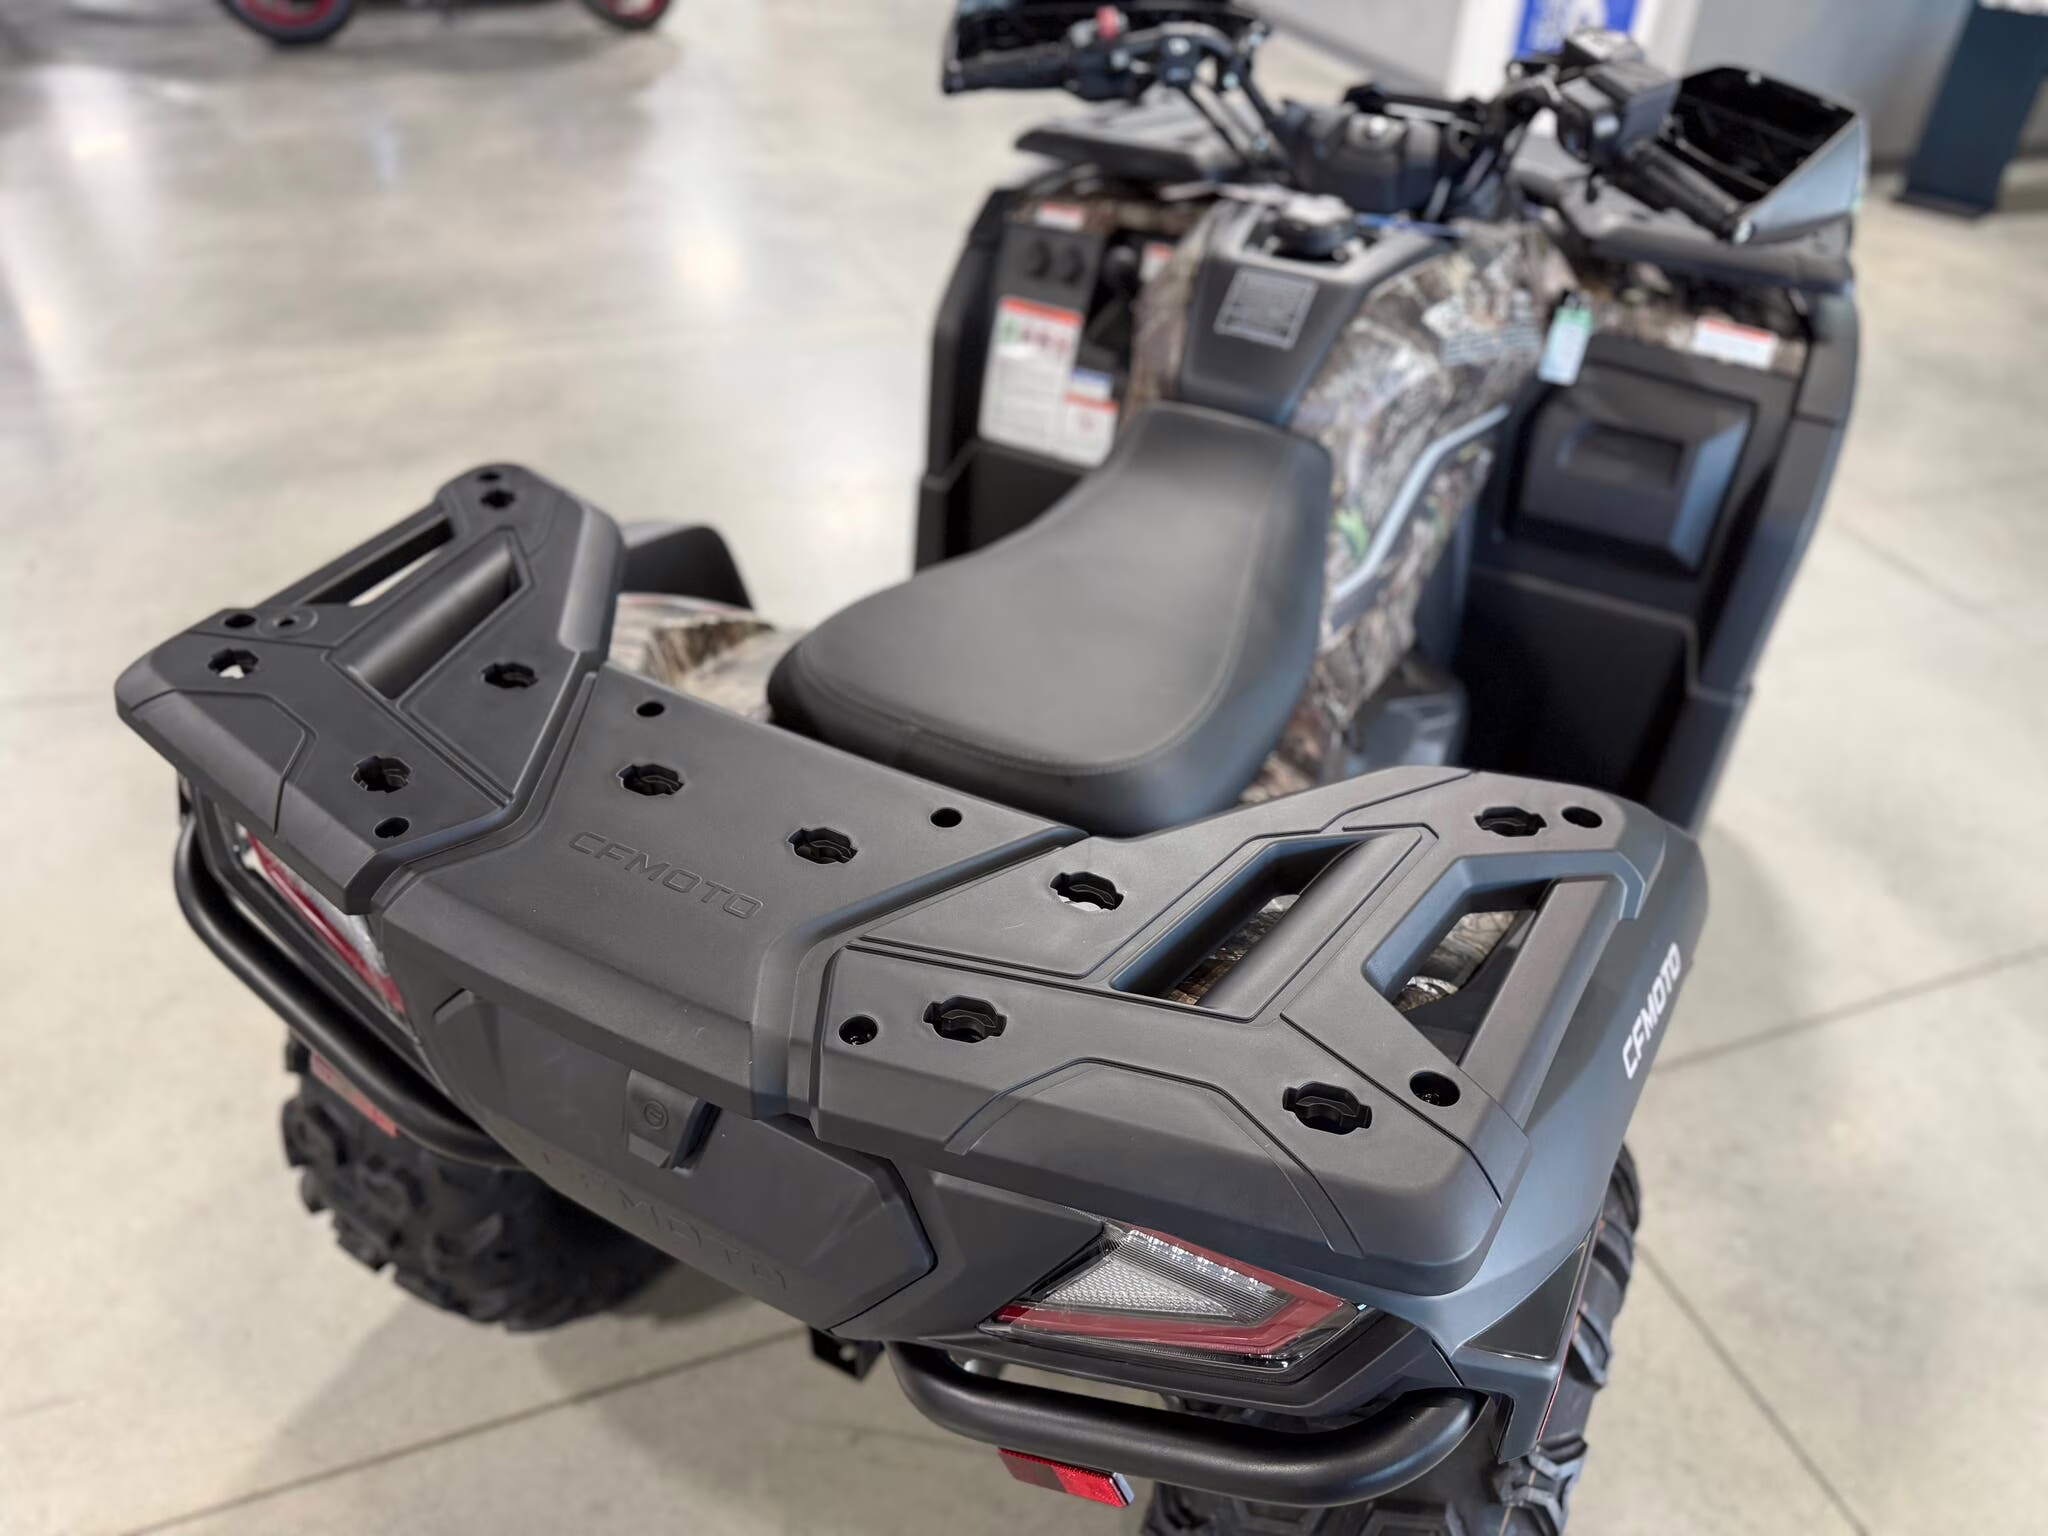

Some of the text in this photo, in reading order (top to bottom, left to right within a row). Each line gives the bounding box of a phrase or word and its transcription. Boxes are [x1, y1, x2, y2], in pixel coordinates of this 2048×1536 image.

[569, 831, 764, 920] CFMOTO
[1622, 941, 1681, 1080] CFMOTO
[541, 1151, 789, 1292] MOTO
